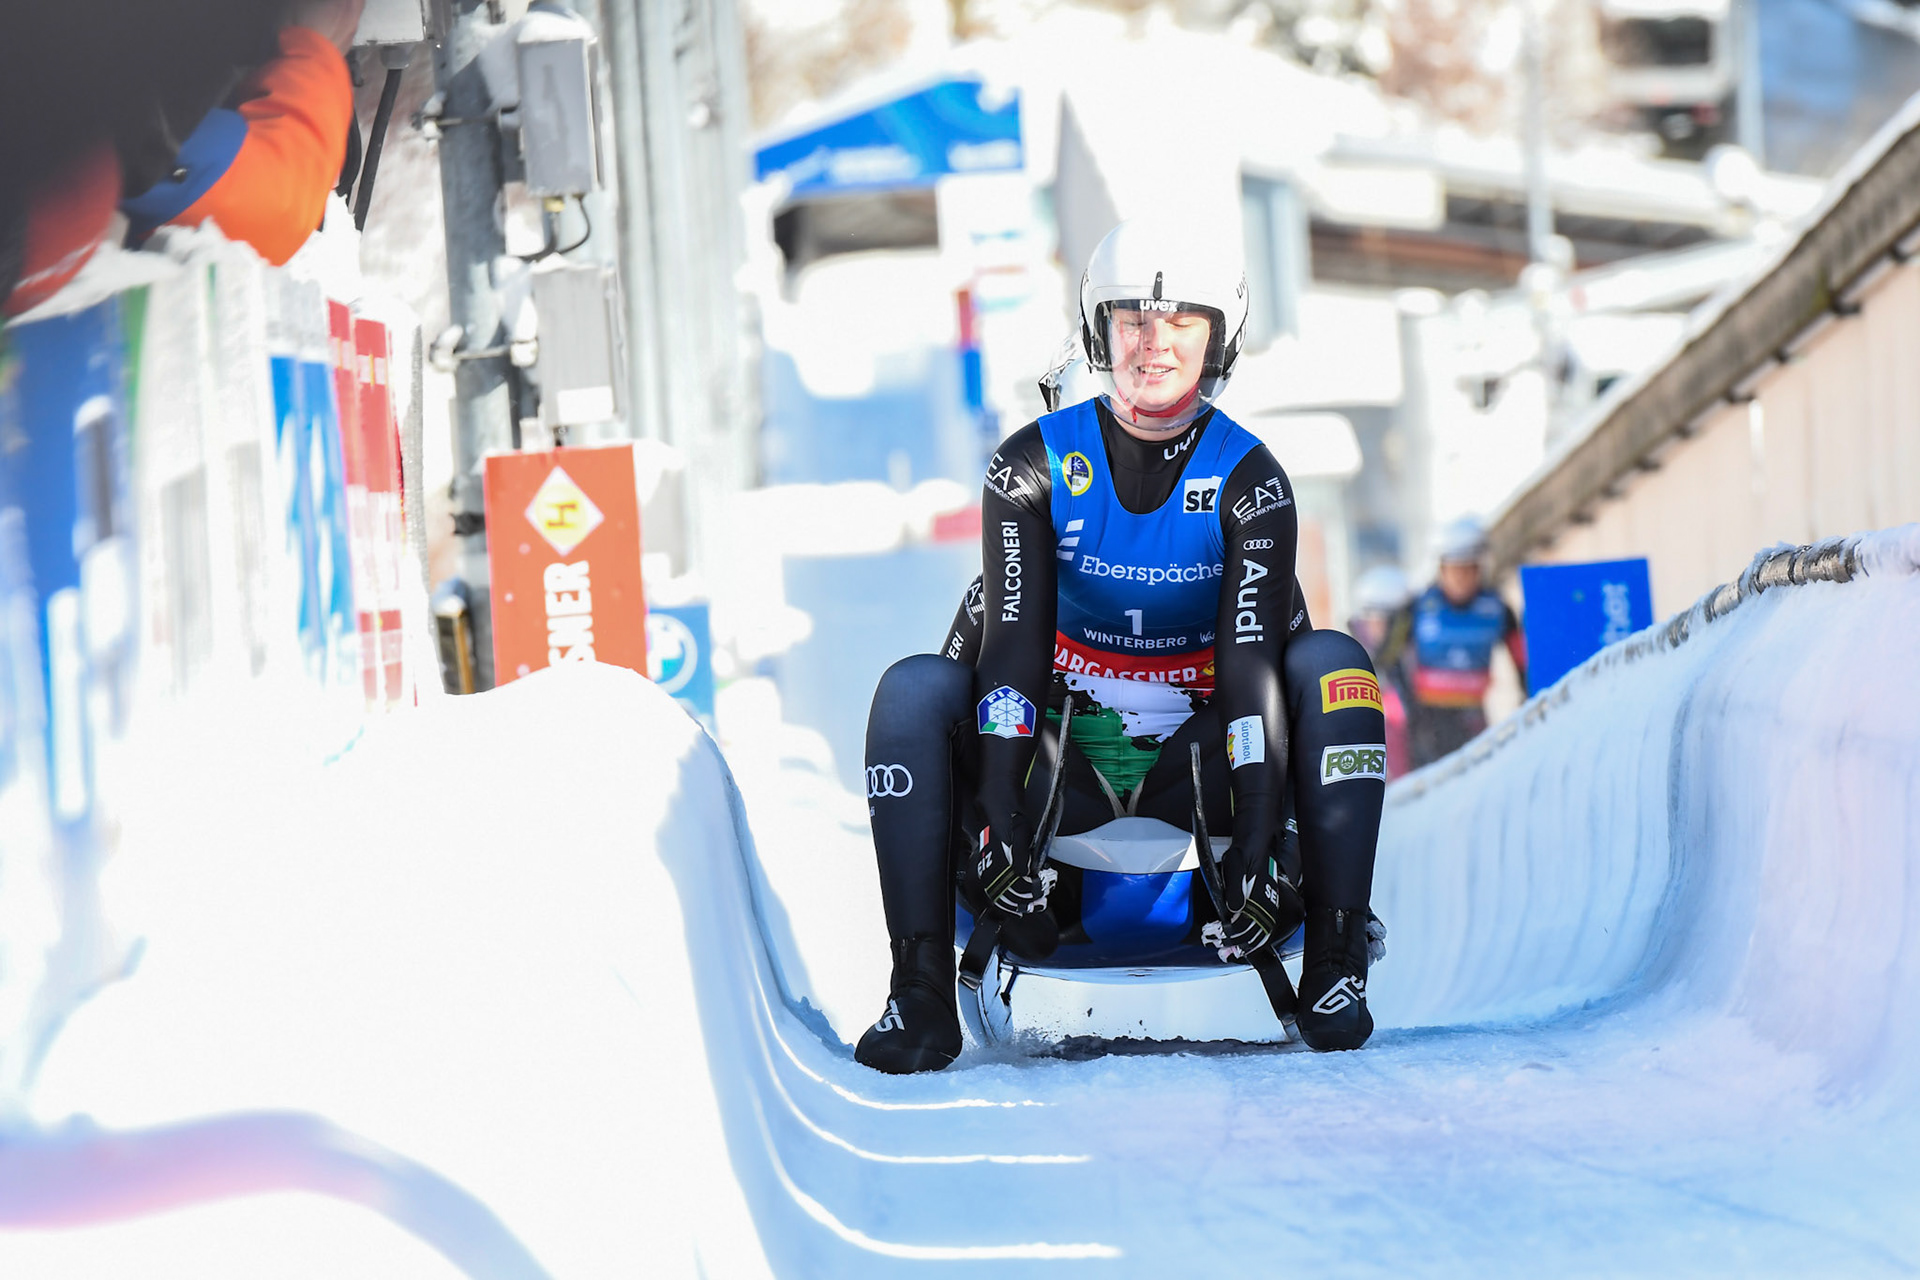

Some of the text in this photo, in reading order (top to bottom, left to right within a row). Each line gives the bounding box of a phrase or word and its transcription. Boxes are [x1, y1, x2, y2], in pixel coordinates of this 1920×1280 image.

[1139, 299, 1178, 312] uvex
[1232, 477, 1284, 519] EA7
[1001, 521, 1022, 622] FALCONERI
[1079, 554, 1224, 586] Eberspäche
[1235, 558, 1269, 644] Audi
[1124, 608, 1143, 636] 1
[946, 631, 965, 661] ERI
[1083, 626, 1188, 650] WINTERBERG
[986, 690, 1027, 706] FISI
[1325, 749, 1386, 778] FORST
